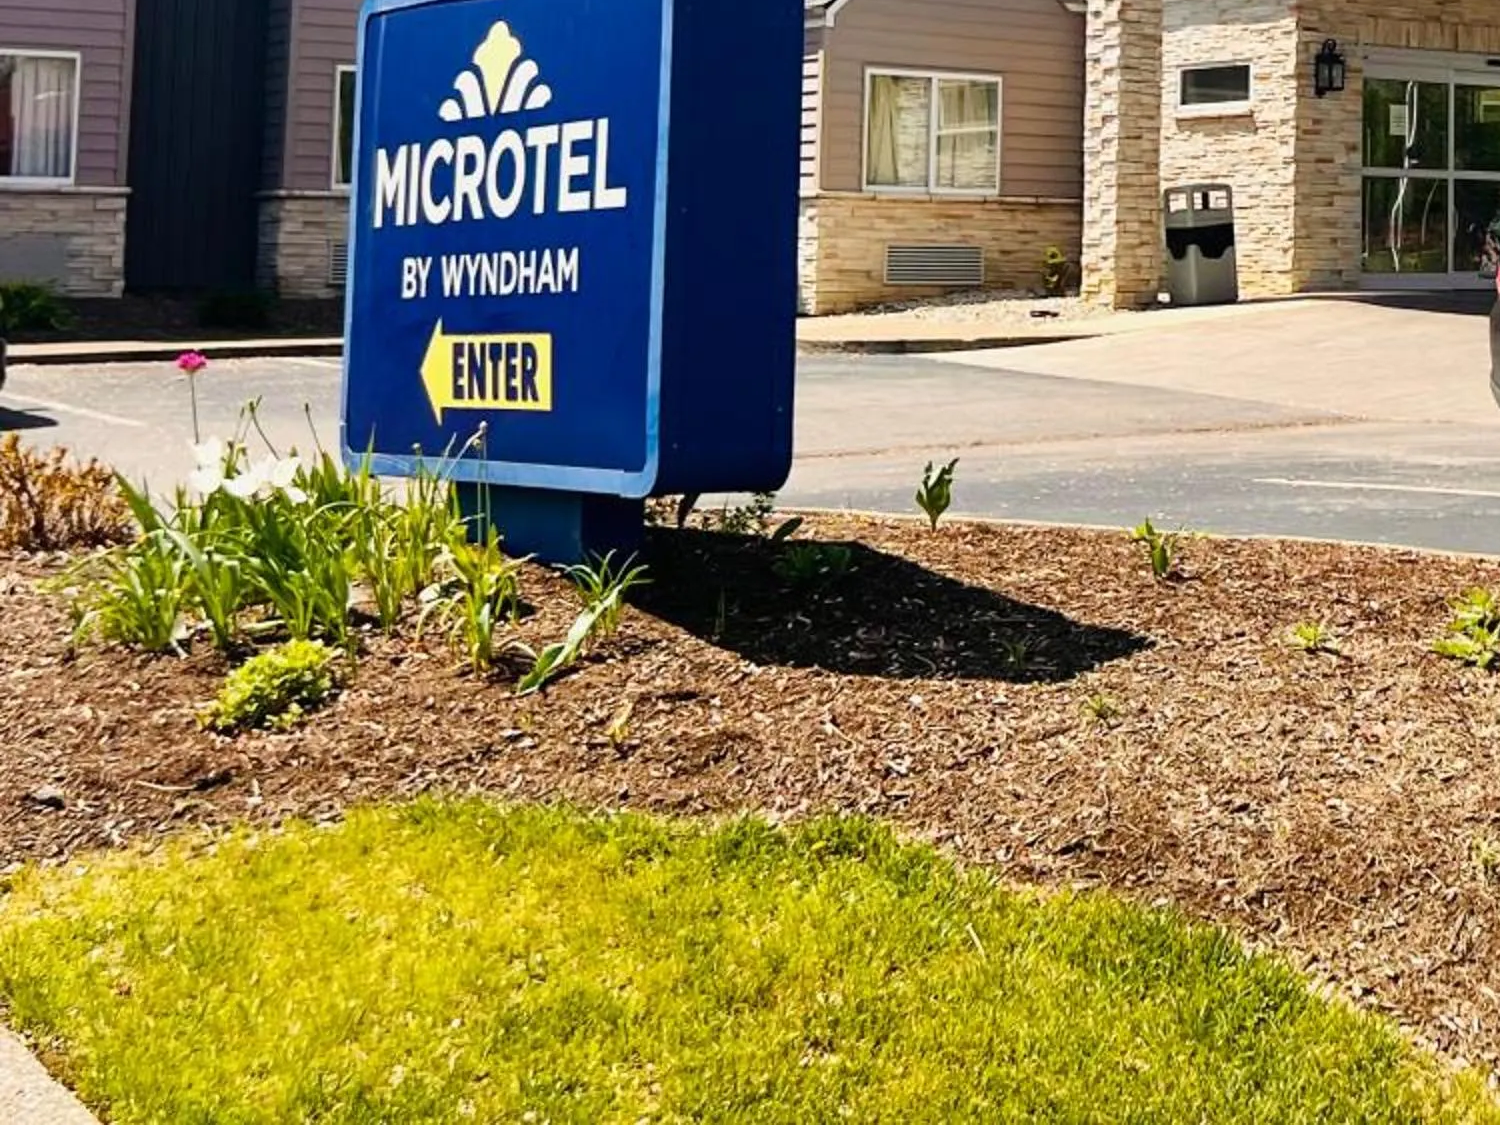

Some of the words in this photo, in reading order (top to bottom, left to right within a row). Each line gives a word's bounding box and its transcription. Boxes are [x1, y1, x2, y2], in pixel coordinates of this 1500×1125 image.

[373, 117, 627, 229] MICROTEL
[401, 256, 433, 299] BY
[440, 247, 579, 298] WYNDHAM
[451, 341, 539, 402] ENTER
